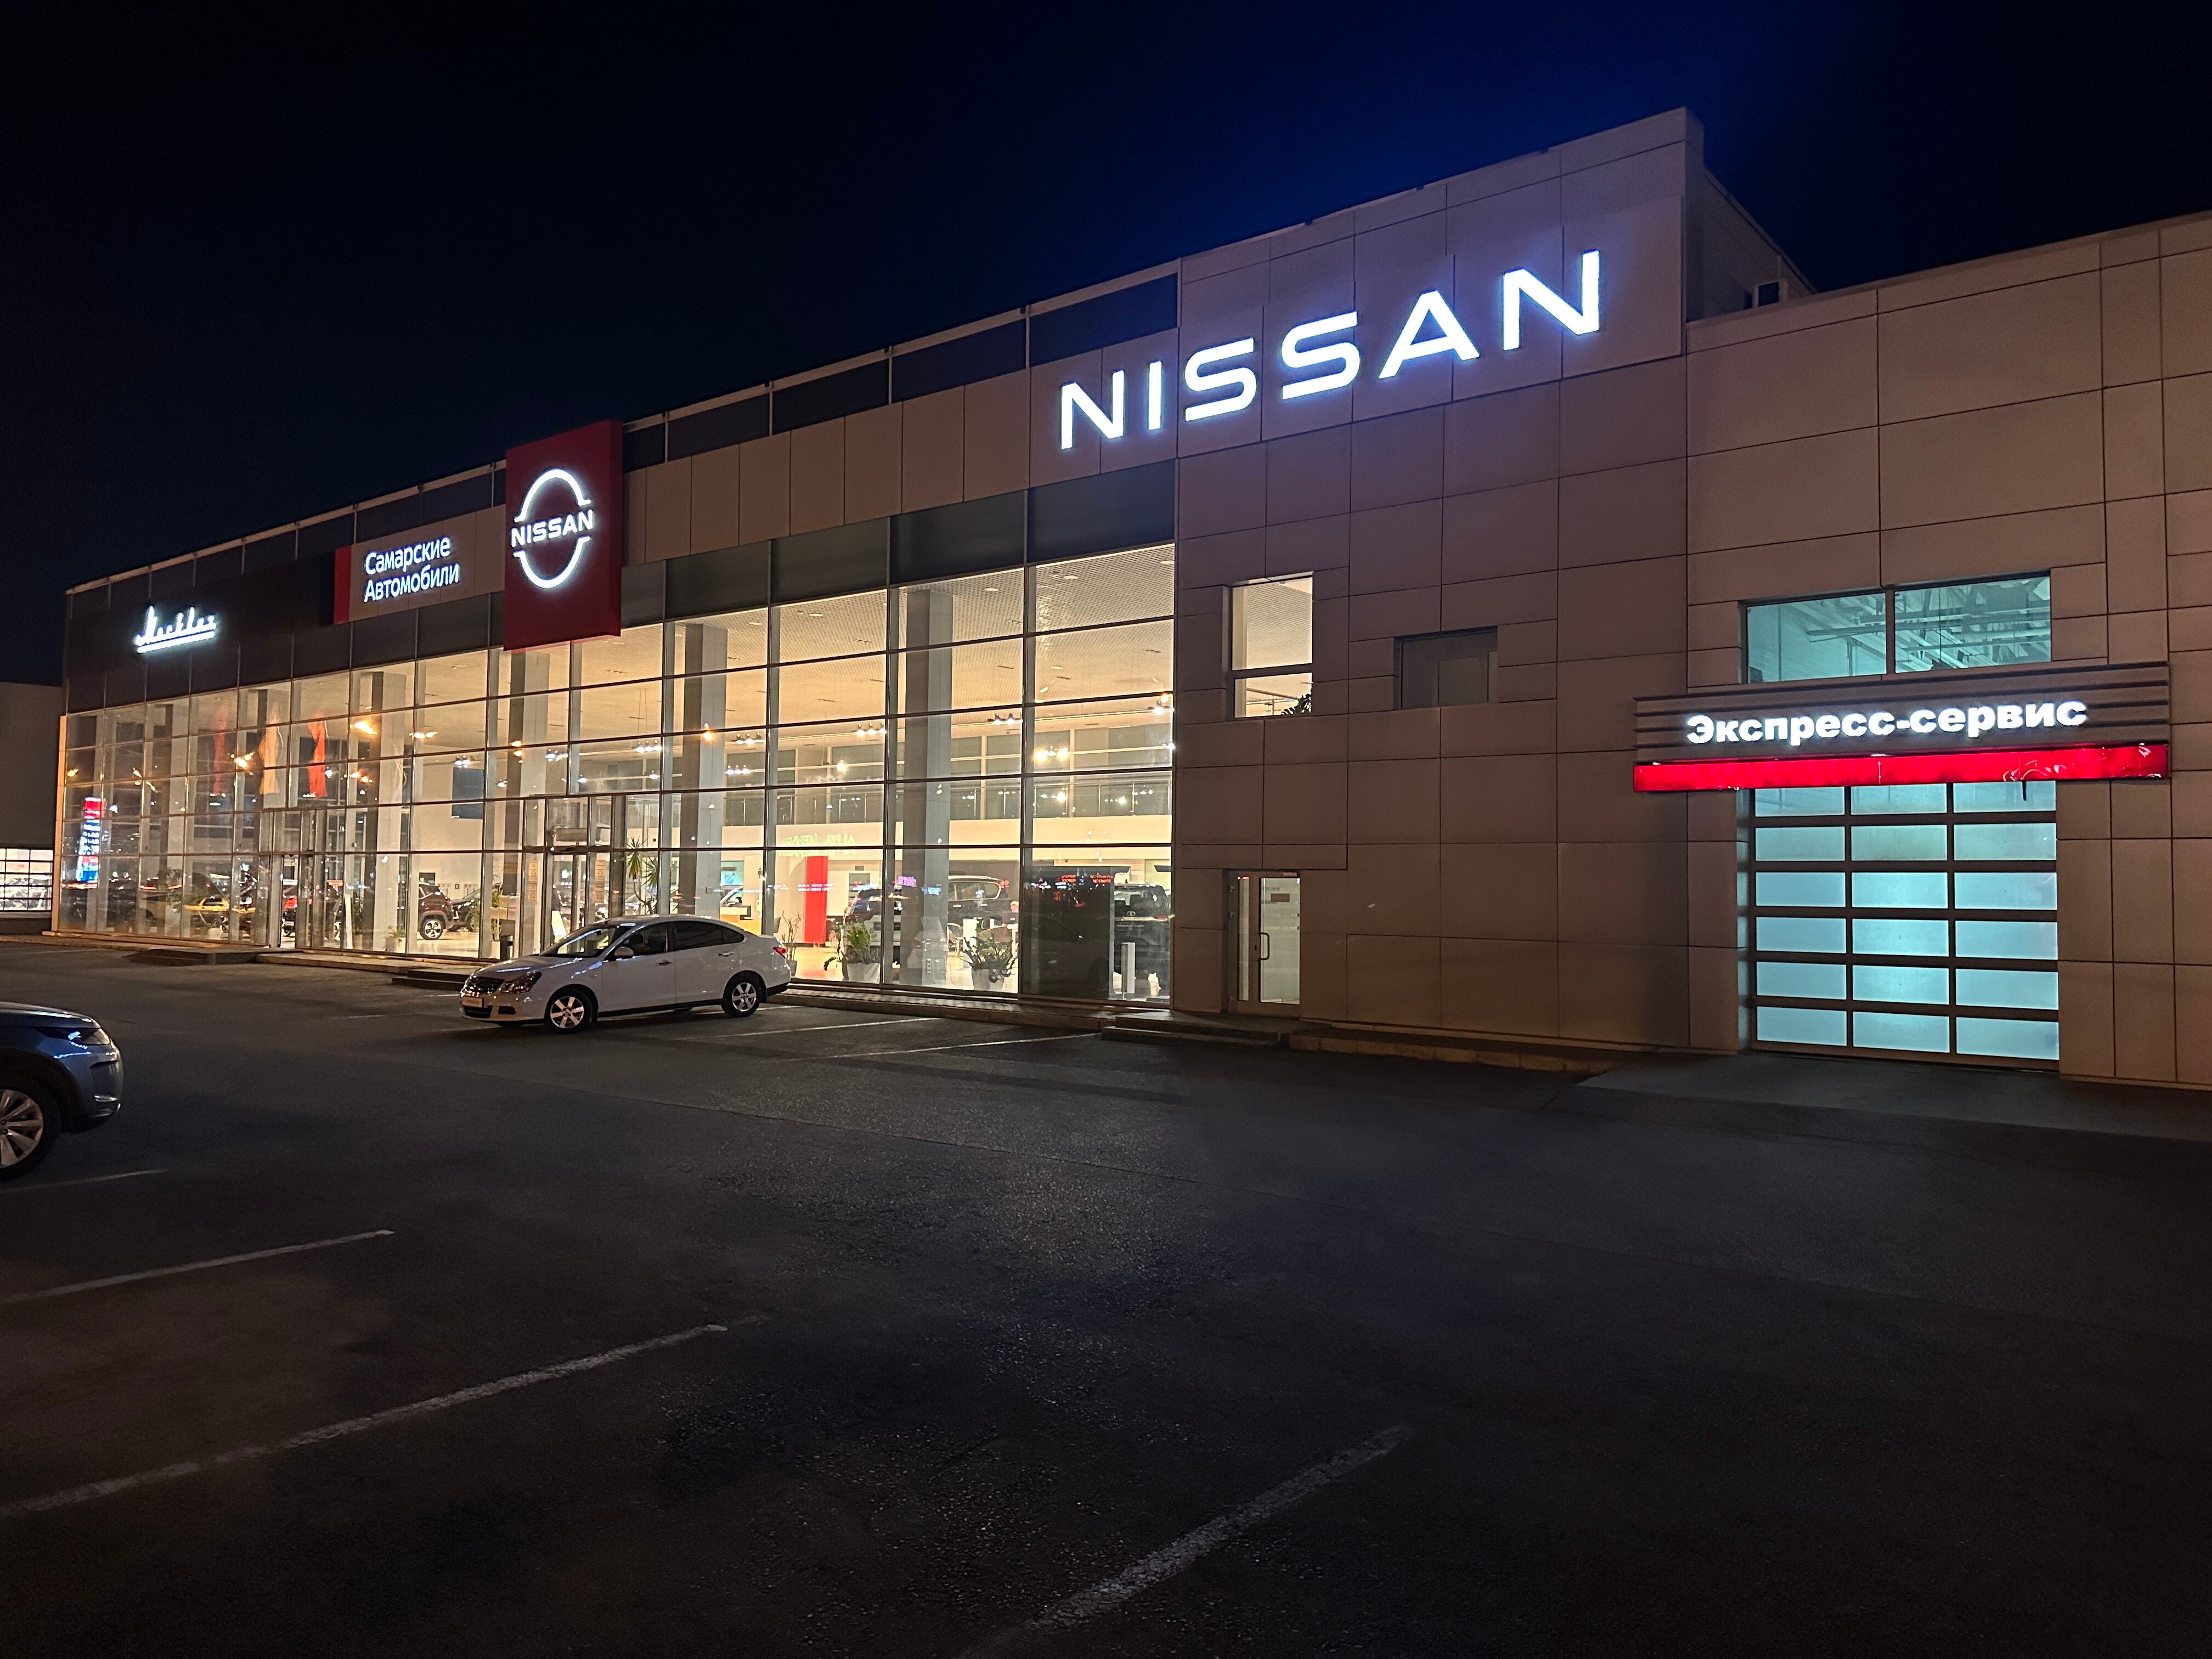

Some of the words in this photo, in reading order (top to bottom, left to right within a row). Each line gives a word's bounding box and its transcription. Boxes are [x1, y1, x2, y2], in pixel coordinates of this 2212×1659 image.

[1060, 250, 1600, 450] NISSAN
[511, 509, 594, 548] NISSAN
[365, 536, 451, 575] Самарские
[363, 563, 460, 603] Автомобили
[1686, 700, 2088, 747] Экспресс-сервис
